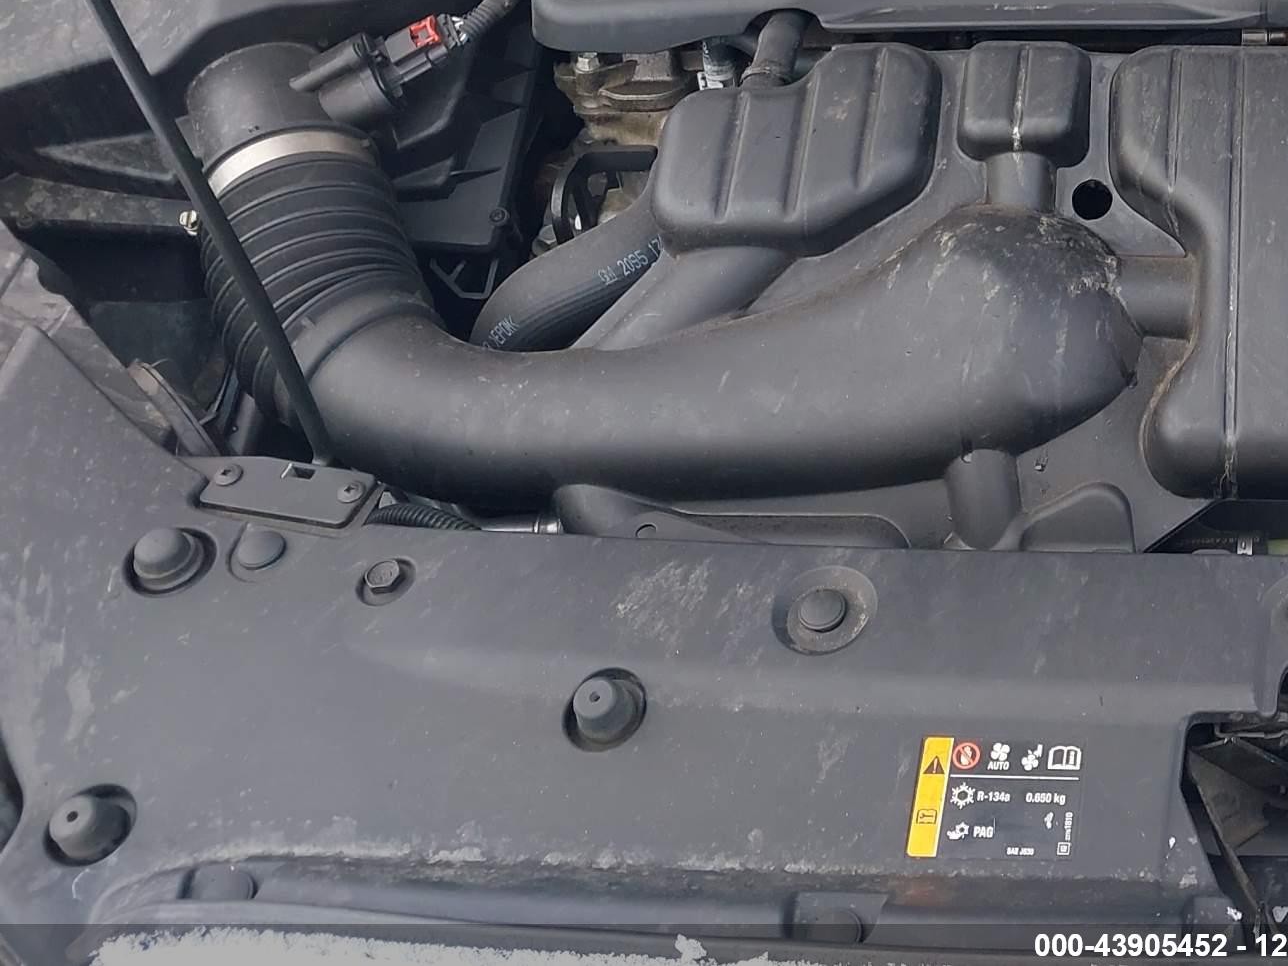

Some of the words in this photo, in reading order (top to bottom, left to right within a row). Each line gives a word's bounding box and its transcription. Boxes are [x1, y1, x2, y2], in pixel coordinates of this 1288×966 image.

[616, 249, 649, 277] 2095
[987, 761, 1010, 771] AUTO
[976, 791, 1011, 802] R-134a
[1053, 793, 1066, 806] kg
[973, 826, 994, 838] PAG
